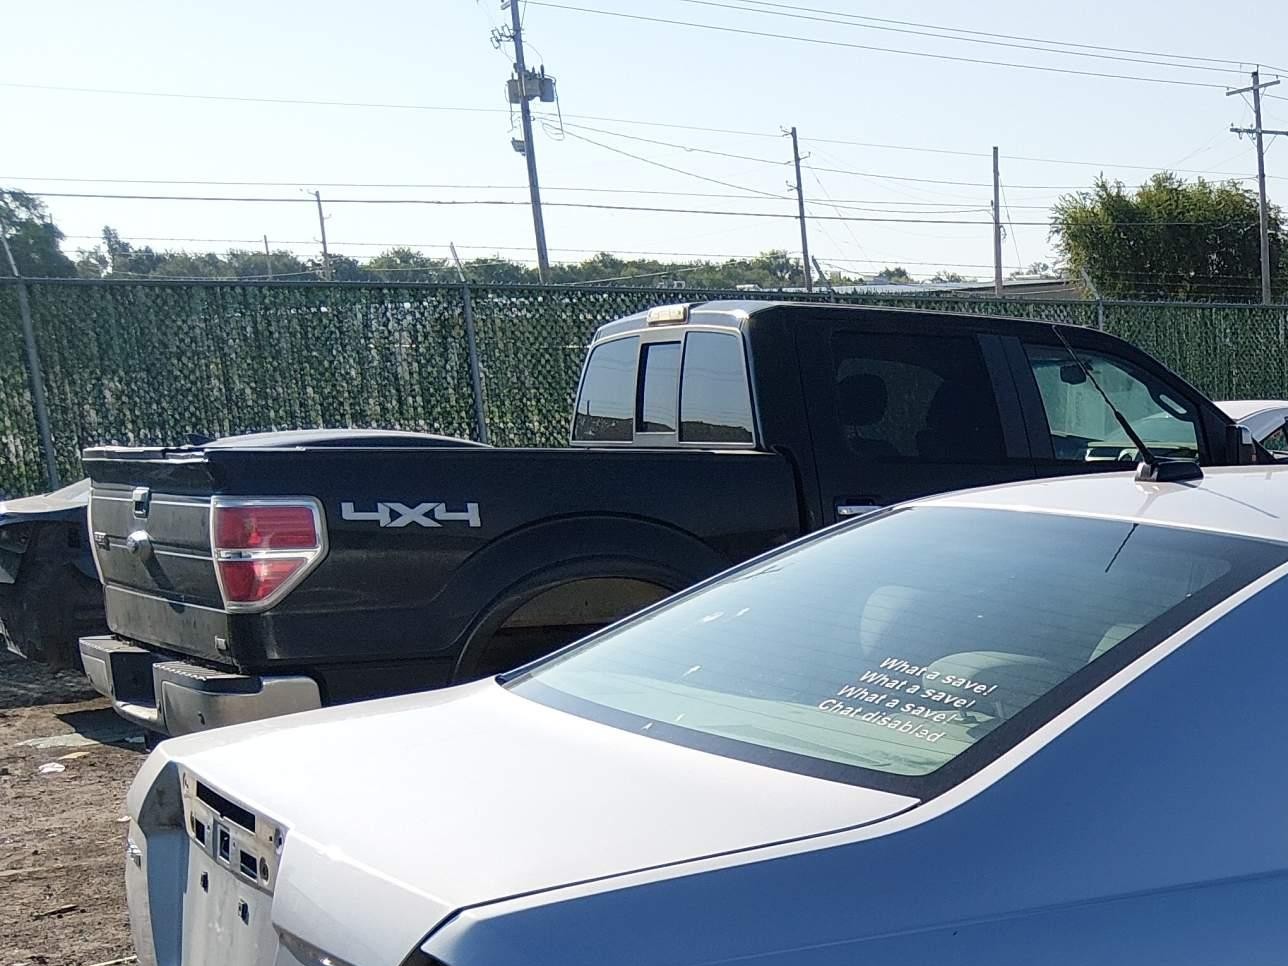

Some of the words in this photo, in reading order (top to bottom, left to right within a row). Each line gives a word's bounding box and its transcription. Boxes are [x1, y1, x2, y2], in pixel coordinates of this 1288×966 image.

[859, 670, 906, 690] What
[906, 683, 921, 694] a
[921, 687, 977, 710] save!
[879, 657, 928, 677] What
[926, 669, 939, 680] a
[941, 673, 999, 697] save!
[818, 699, 863, 718] Chat
[861, 712, 947, 744] disabled
[837, 684, 888, 704] What
[885, 698, 900, 709] a
[900, 701, 957, 725] save!
